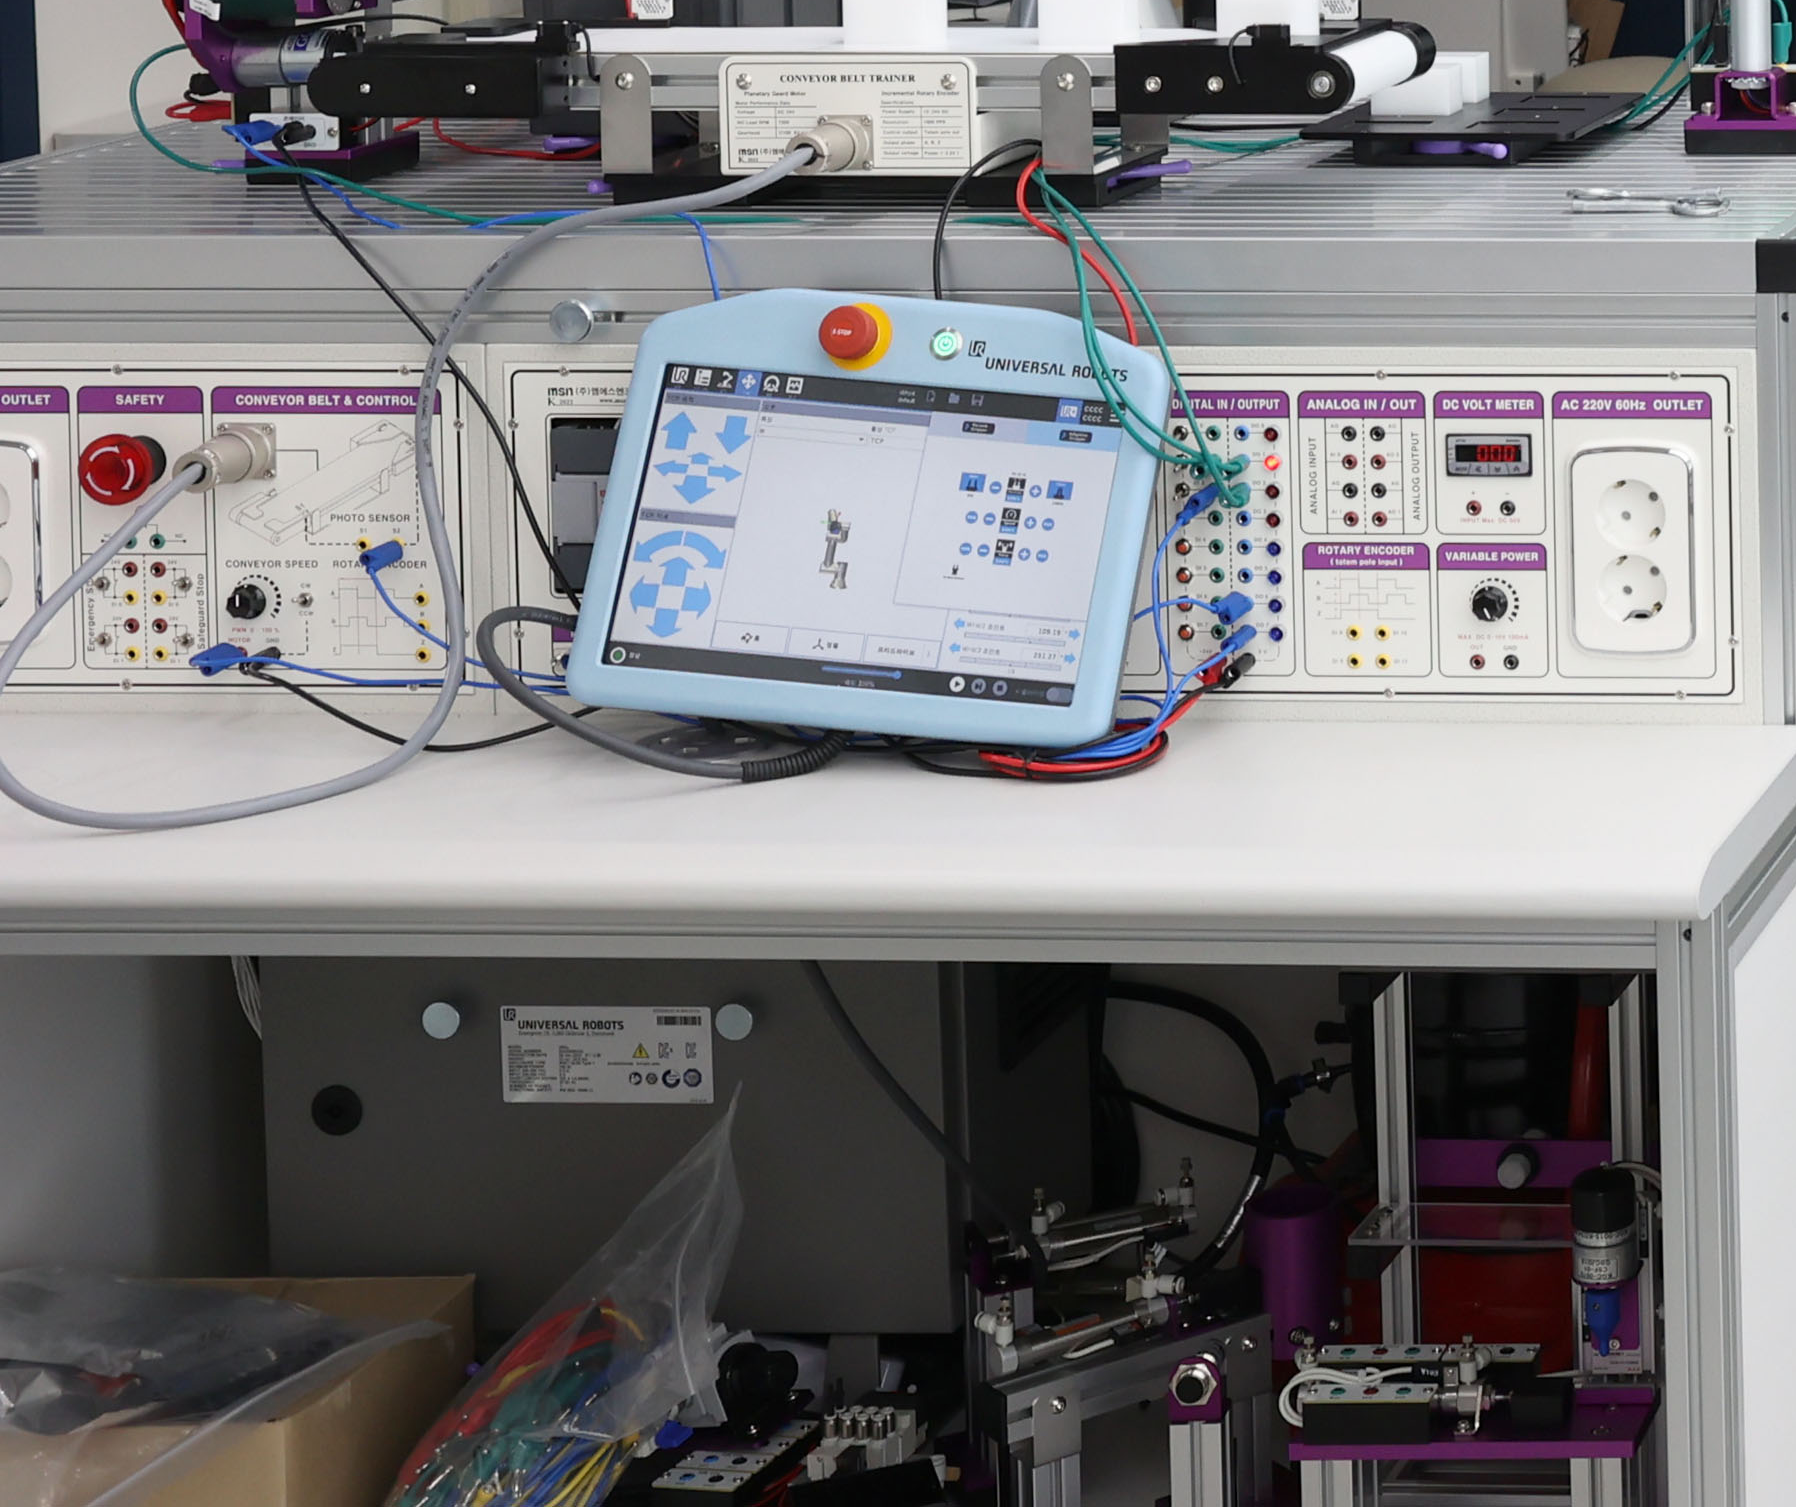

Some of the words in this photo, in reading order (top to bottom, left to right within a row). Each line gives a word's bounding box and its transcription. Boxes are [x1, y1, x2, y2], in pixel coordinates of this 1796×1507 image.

[780, 74, 837, 83] CONVEYOR
[840, 74, 866, 83] BELT
[870, 74, 915, 83] TRAINER
[985, 357, 1066, 377] UNIVERSAL
[1, 394, 51, 406] OUTLET
[115, 394, 165, 406] SAFETY
[235, 395, 306, 406] CONVEYOR
[308, 395, 341, 406] BELT
[344, 395, 354, 406] &
[356, 395, 417, 407] CONTROL
[1172, 398, 1214, 411] DIITAL
[1217, 399, 1229, 410] IN
[1237, 398, 1280, 410] OUTPUT
[1307, 399, 1360, 410] ANALOG
[1362, 399, 1376, 410] IN
[1389, 399, 1417, 410] OUT
[1443, 400, 1460, 410] DC
[1462, 400, 1492, 410] VOLT
[1495, 399, 1535, 410] METER
[1561, 400, 1580, 410] AC
[1583, 400, 1612, 411] 220V
[1616, 400, 1646, 410] 60Hz
[1653, 400, 1704, 410] OUTLET
[1308, 437, 1317, 468] INPUT
[1411, 432, 1420, 474] OUTPUT
[1309, 470, 1317, 515] ANALOG
[1412, 476, 1421, 520] ANALOG
[330, 514, 366, 523] PHOTO
[369, 514, 411, 523] SENSOR
[1318, 545, 1361, 555] ROTARY
[1364, 545, 1414, 555] ENCODER
[1445, 552, 1498, 561] VARIABLE
[1501, 552, 1539, 561] POWER
[225, 561, 281, 569] CONVEYOR
[285, 561, 319, 569] SPEED
[333, 561, 365, 569] ROTA
[385, 561, 427, 569] NCODER
[197, 598, 206, 650] Safeguard
[518, 1020, 579, 1030] UNIVERSAL
[583, 1020, 625, 1030] ROBOTS
